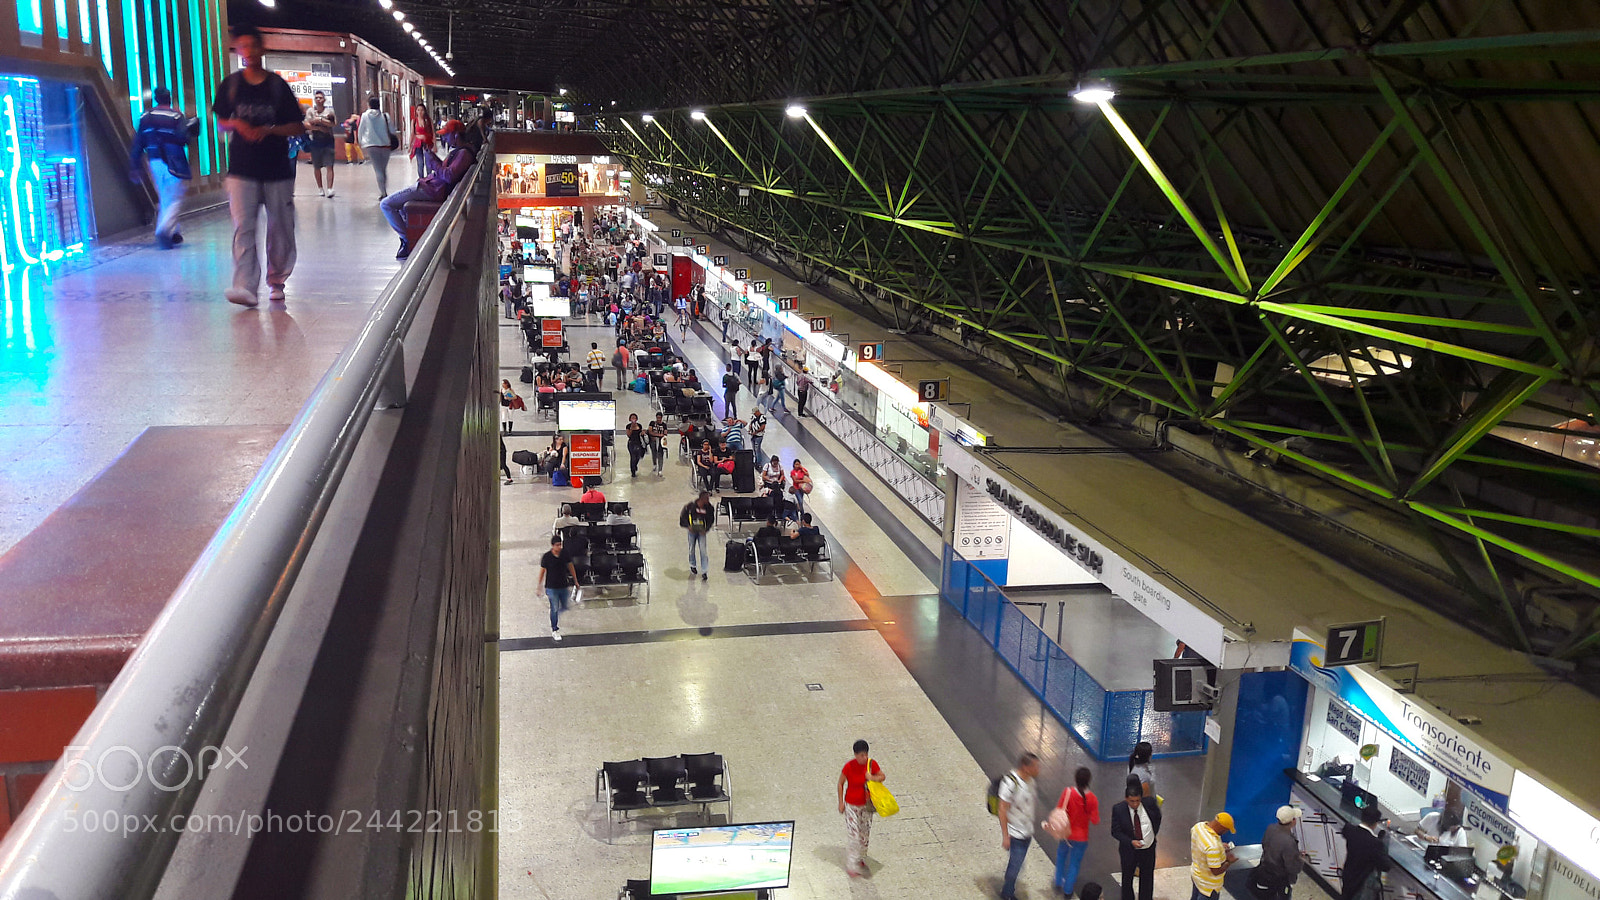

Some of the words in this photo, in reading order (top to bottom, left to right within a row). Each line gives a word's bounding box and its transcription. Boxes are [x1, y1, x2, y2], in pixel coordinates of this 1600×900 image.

[684, 238, 692, 246] 16
[698, 246, 706, 254] 15
[715, 257, 724, 265] 14
[736, 270, 746, 278] 13
[755, 282, 766, 292] 12
[780, 299, 791, 309] 11
[812, 319, 825, 330] 10
[863, 345, 874, 360] 9
[924, 383, 936, 399] 8
[1123, 568, 1140, 587] South
[1142, 580, 1171, 610] boarding
[1133, 591, 1148, 606] gate
[1339, 630, 1357, 659] 7
[1400, 700, 1491, 774] Transoriente
[1553, 860, 1574, 881] ALTO
